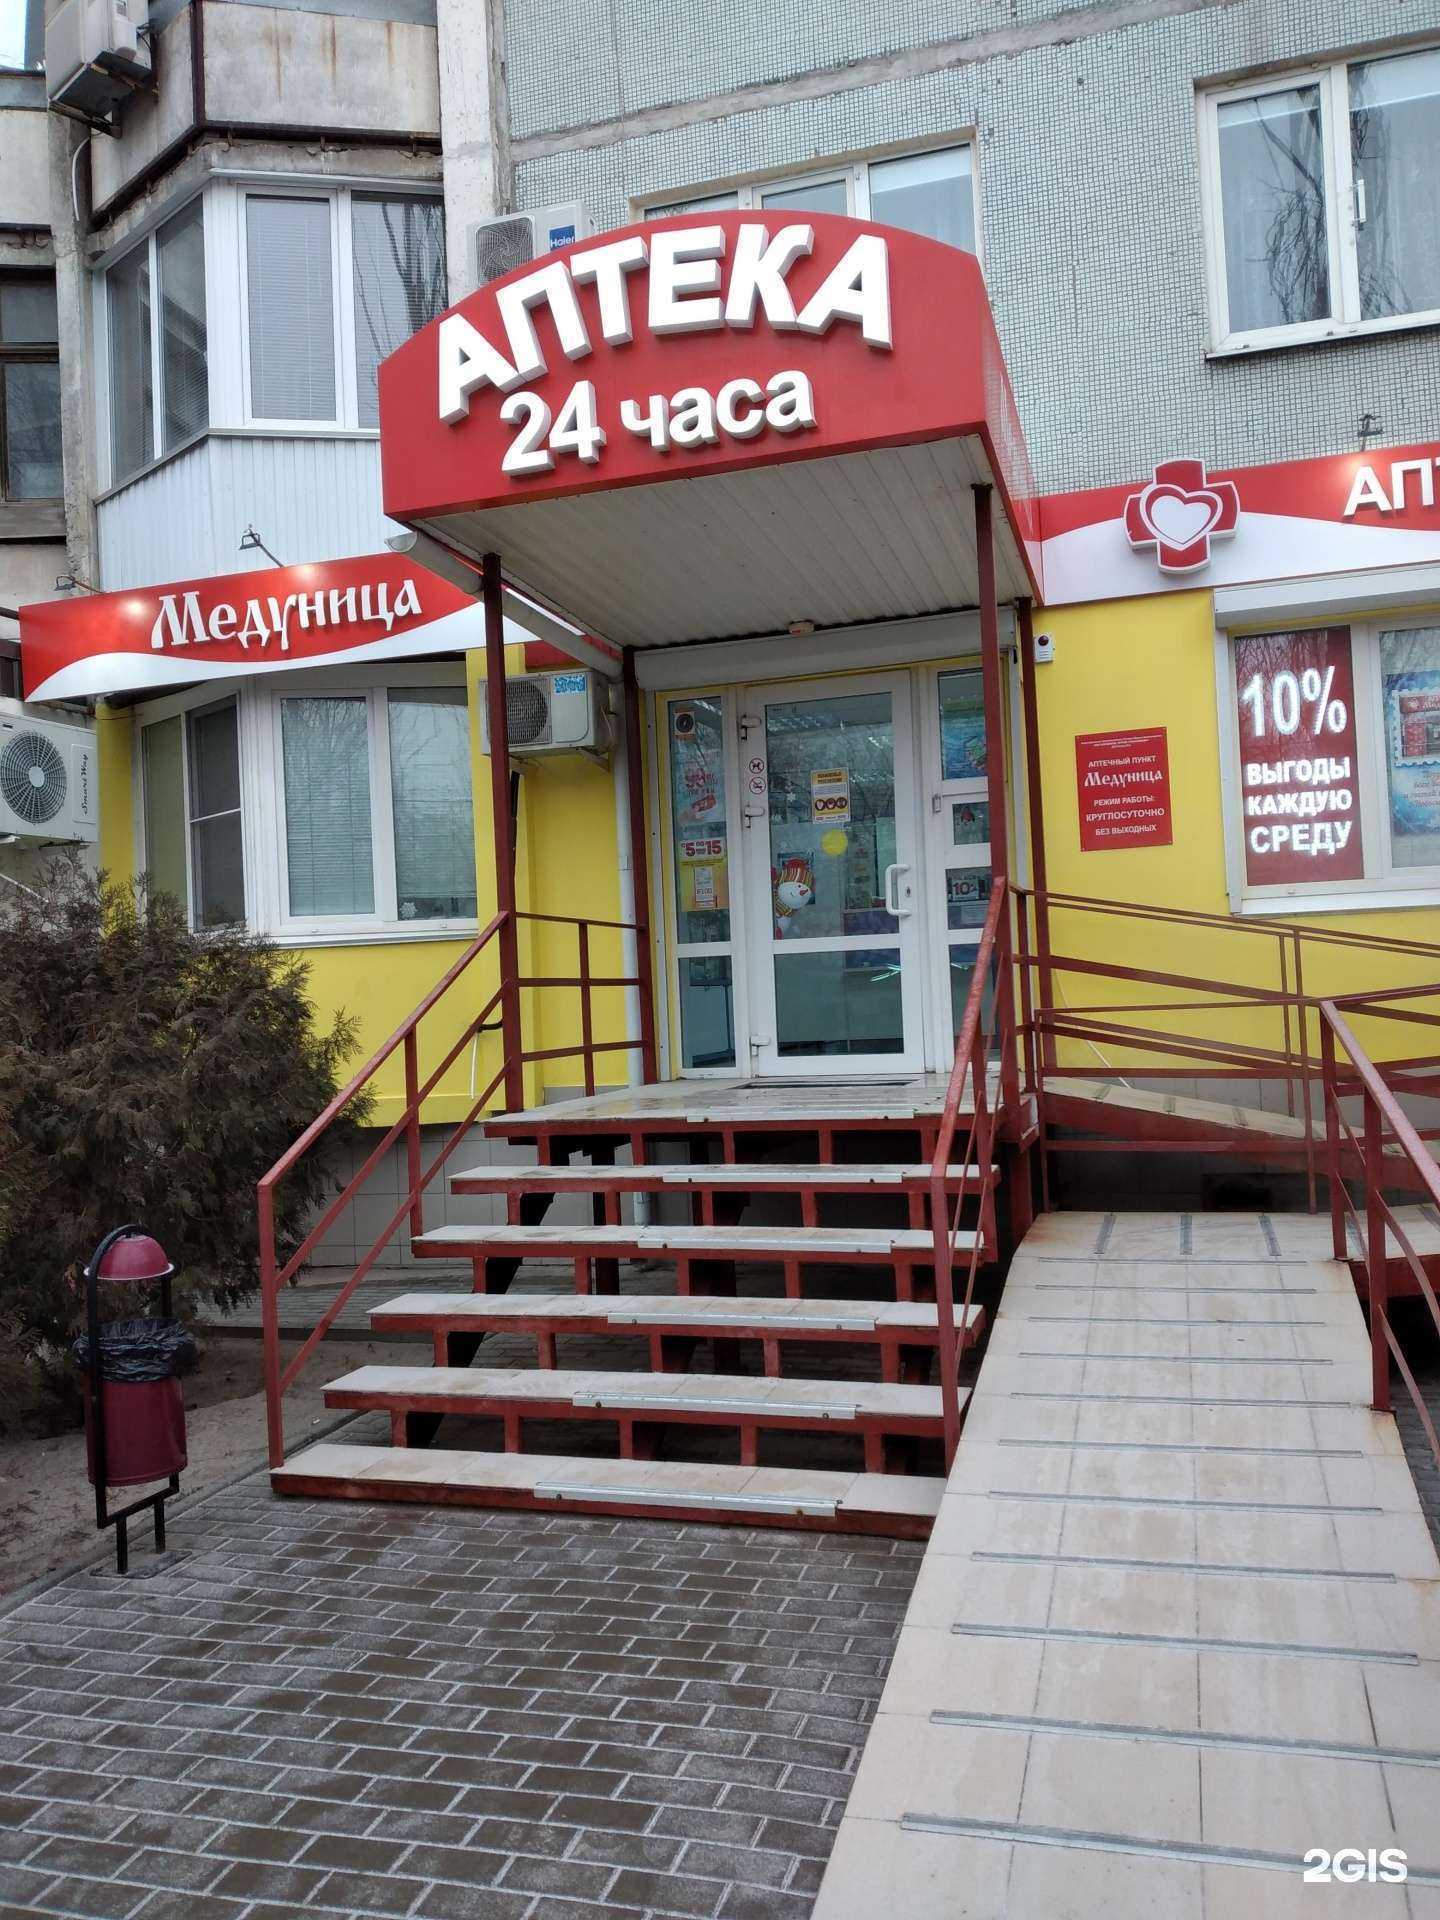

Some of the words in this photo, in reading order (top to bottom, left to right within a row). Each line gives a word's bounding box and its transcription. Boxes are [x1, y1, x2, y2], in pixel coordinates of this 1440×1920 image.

[438, 223, 894, 425] АПТЕКА
[500, 379, 607, 477] 24
[621, 369, 818, 453] часа
[1343, 457, 1440, 517] АП
[151, 579, 422, 651] Медуница
[1240, 665, 1348, 737] 10%
[1088, 757, 1131, 768] АПТЕЧНЫЙ
[1132, 755, 1157, 764] ПУНКТ
[1246, 757, 1351, 786] ВЫГОДЫ
[1084, 770, 1164, 788] Медуница
[1086, 808, 1165, 822] КРУГЛОСУТОЧНО
[1094, 796, 1121, 806] РЕЖИМ
[1247, 789, 1353, 817] КАЖДУЮ
[1095, 828, 1110, 836] БЕЗ
[1112, 824, 1157, 834] ВЫХОДНЫХ
[1250, 820, 1353, 856] СРЕДУ
